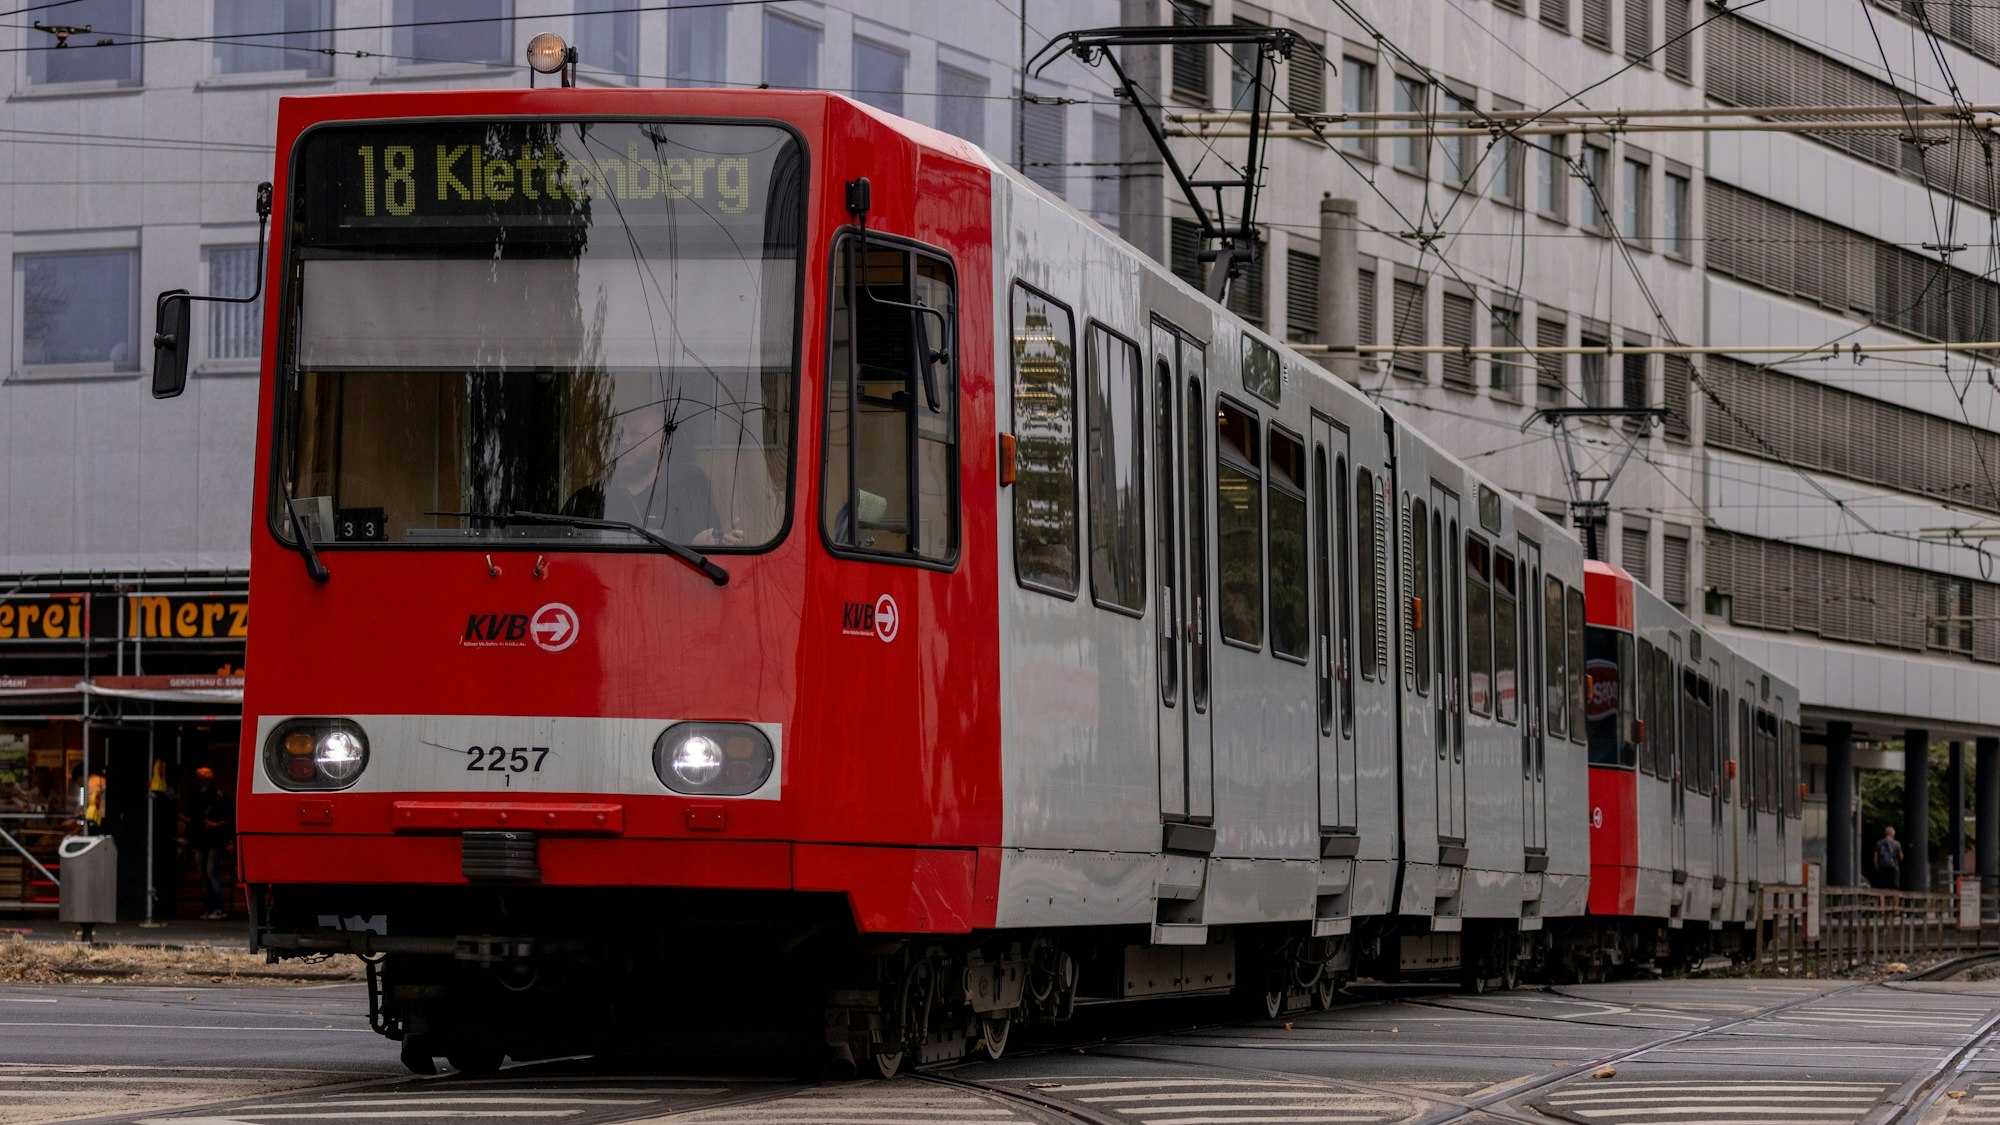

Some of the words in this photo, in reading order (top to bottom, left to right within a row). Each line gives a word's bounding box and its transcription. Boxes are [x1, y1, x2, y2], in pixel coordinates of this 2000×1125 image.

[358, 145, 416, 217] 18
[436, 140, 749, 214] Klettenberg
[0, 595, 81, 638] erei
[464, 613, 529, 641] KVB
[843, 603, 874, 630] KVB
[169, 677, 215, 688] GERÜSTBAU
[466, 745, 550, 773] 2257
[504, 773, 510, 787] 1
